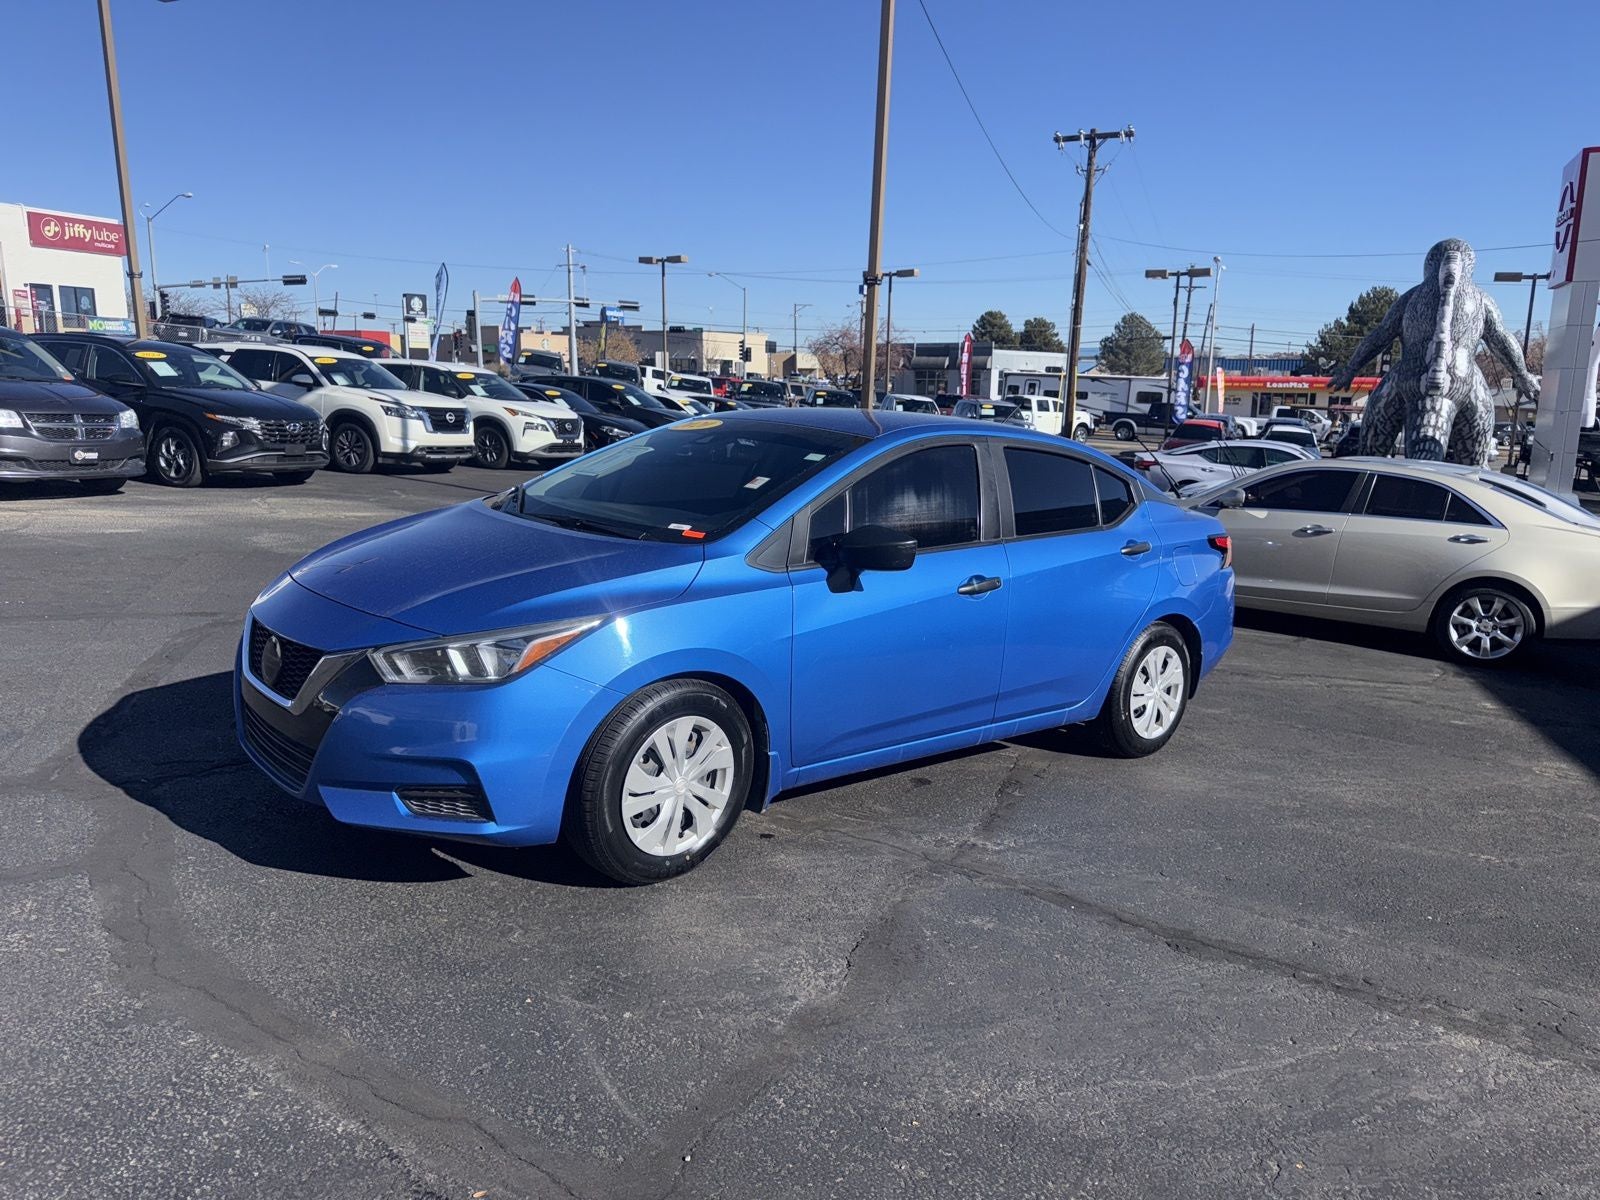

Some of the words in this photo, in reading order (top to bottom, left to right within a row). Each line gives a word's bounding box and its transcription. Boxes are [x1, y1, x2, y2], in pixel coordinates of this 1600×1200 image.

[64, 222, 92, 242] jiffy
[92, 226, 119, 243] lube
[88, 319, 105, 331] NO
[1266, 381, 1310, 389] LoanMax
